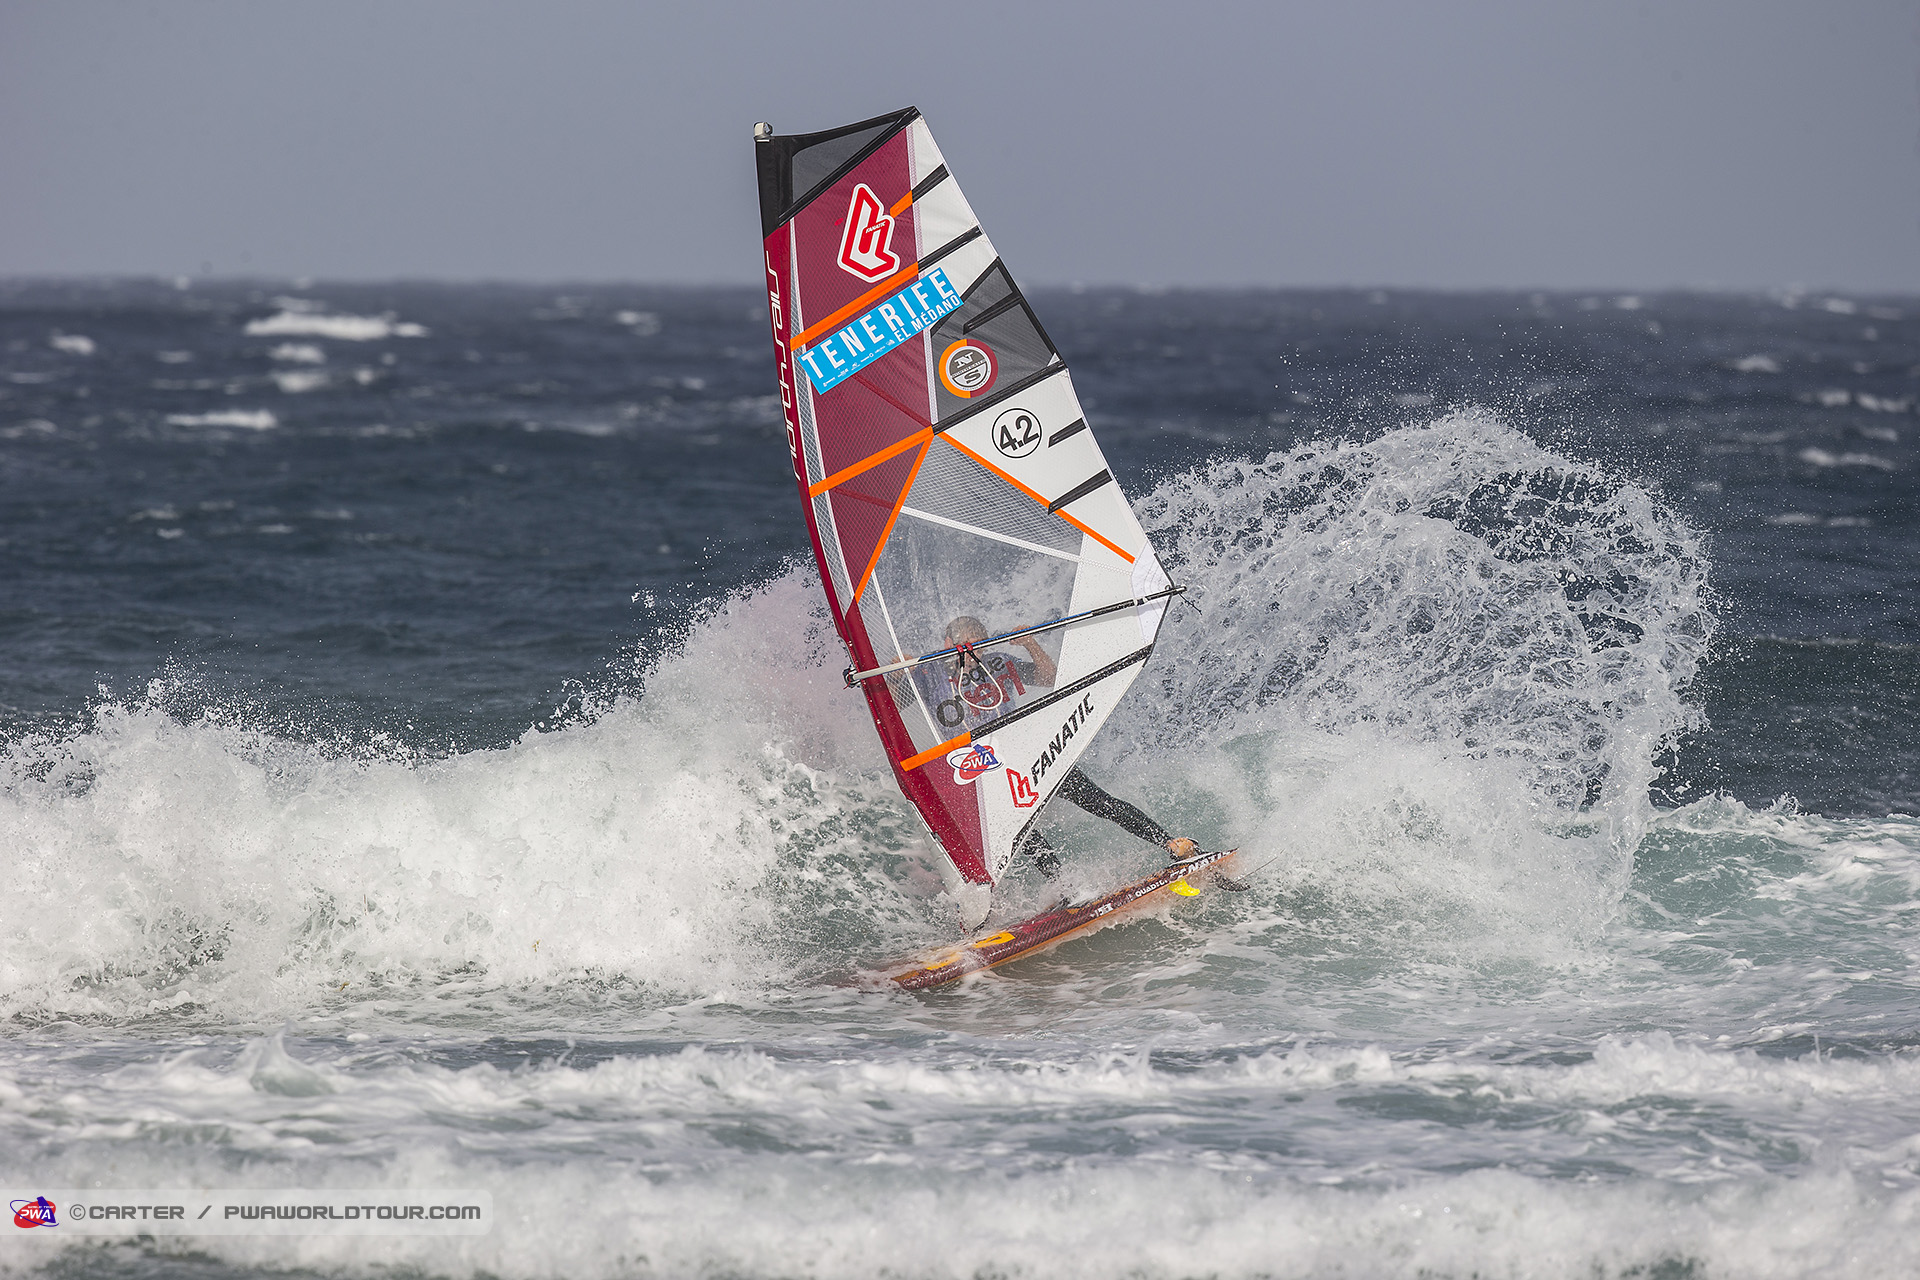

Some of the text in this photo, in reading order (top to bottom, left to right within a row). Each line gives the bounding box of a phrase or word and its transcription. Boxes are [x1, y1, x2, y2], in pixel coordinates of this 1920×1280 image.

[801, 270, 954, 379] TENERIFE
[894, 294, 961, 343] EL MÉDANO
[954, 352, 974, 368] N
[963, 369, 981, 384] S
[1000, 415, 1039, 450] 4.2
[1031, 692, 1094, 786] FANATIC
[963, 753, 993, 772] PWA
